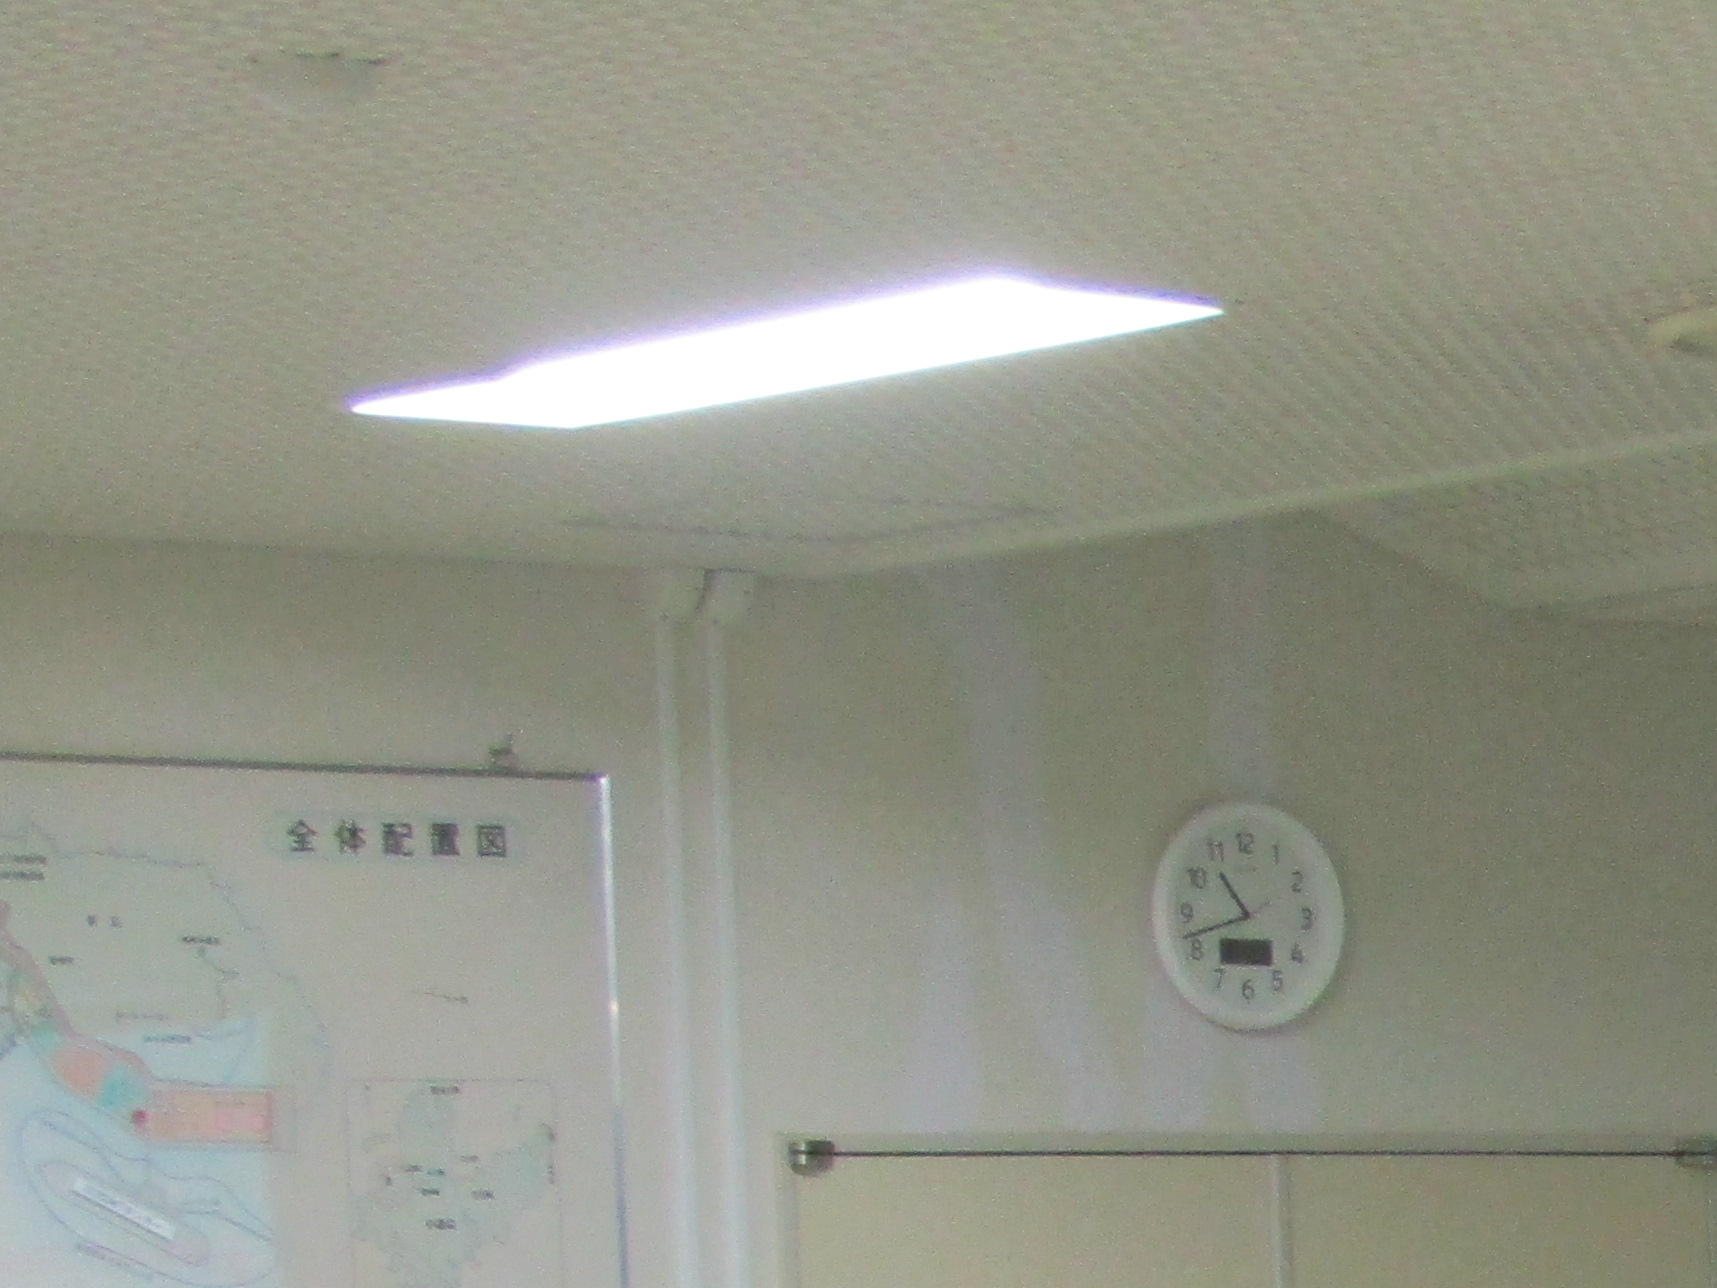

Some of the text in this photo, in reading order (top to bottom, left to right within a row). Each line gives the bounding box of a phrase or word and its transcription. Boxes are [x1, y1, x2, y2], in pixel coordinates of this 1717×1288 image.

[1206, 838, 1225, 862] 11
[1271, 842, 1280, 865] 1
[1187, 867, 1207, 889] 10
[1291, 871, 1303, 893] 2
[1180, 902, 1194, 924] 9
[1301, 905, 1314, 931] 3
[1189, 939, 1204, 961] 8
[1291, 941, 1304, 964] 4
[1214, 968, 1226, 989] 7
[1241, 979, 1255, 1000] 6
[1272, 970, 1284, 992] 5
